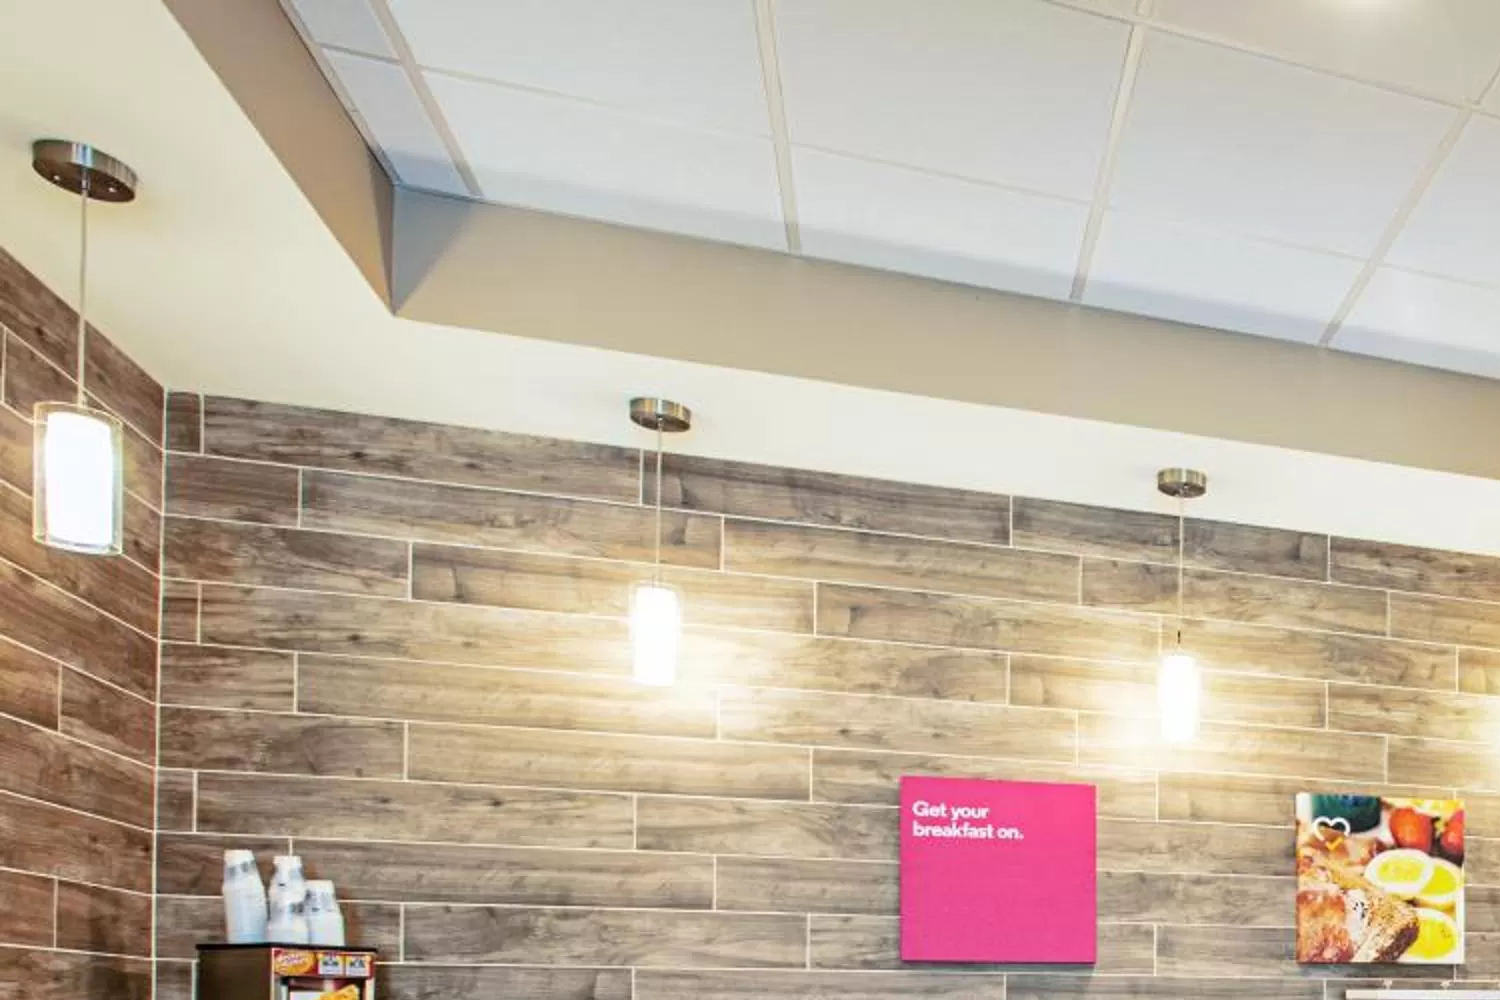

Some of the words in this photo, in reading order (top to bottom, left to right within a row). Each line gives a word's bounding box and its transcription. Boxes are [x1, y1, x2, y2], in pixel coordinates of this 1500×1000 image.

[912, 800, 947, 818] Get
[951, 804, 989, 821] your
[912, 820, 994, 839] breakfast
[997, 827, 1024, 840] on.
